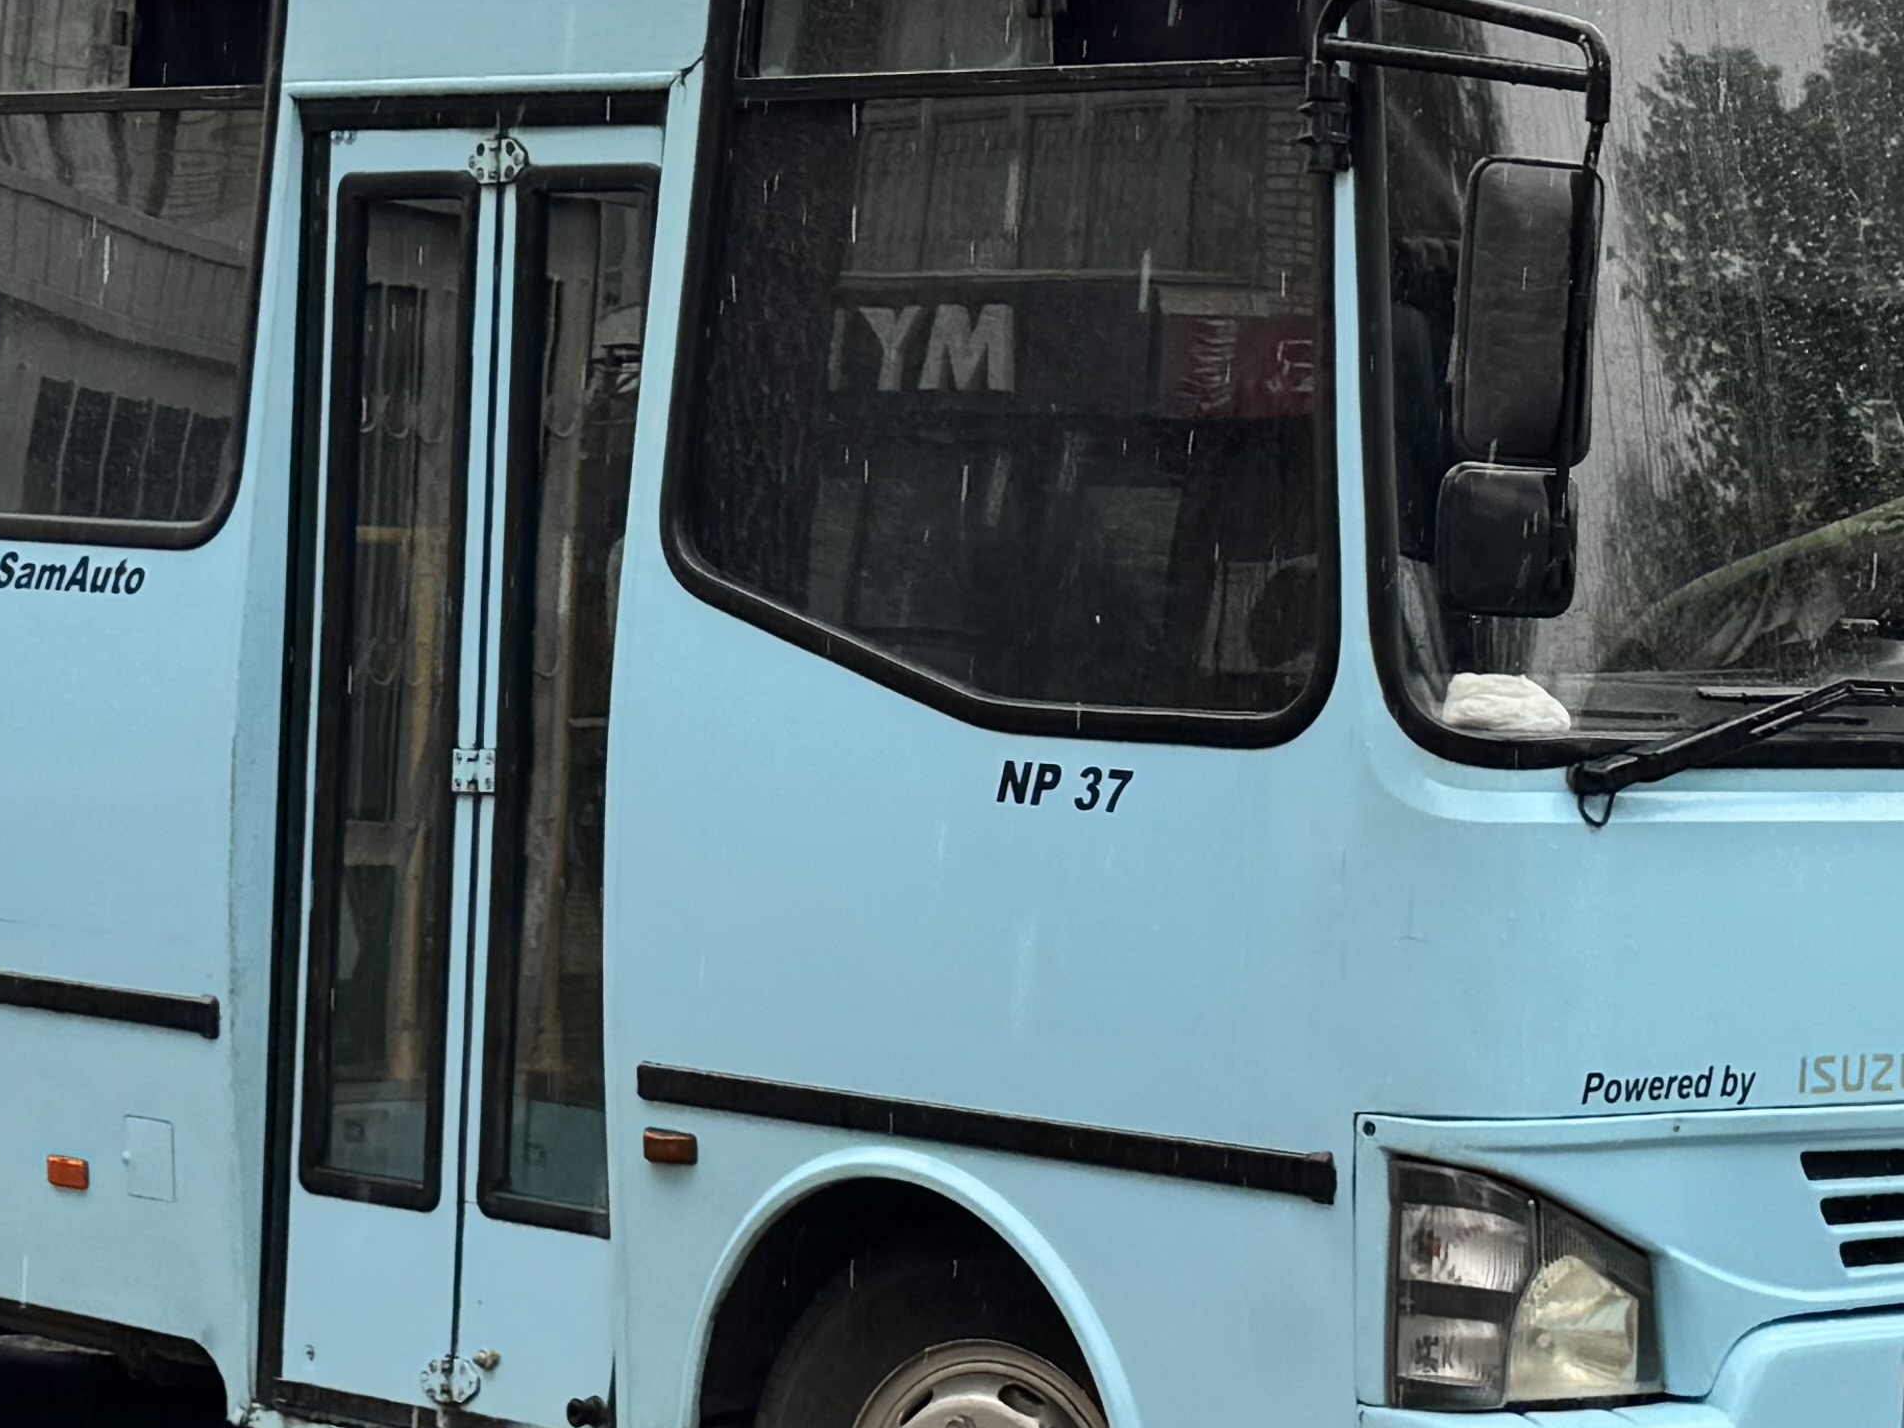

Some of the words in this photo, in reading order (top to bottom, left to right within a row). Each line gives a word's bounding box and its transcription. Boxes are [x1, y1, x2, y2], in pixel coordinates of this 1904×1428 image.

[996, 760, 1062, 806] NP
[1074, 766, 1133, 813] 37
[1582, 1066, 1714, 1104] Powered
[1721, 1064, 1756, 1105] by
